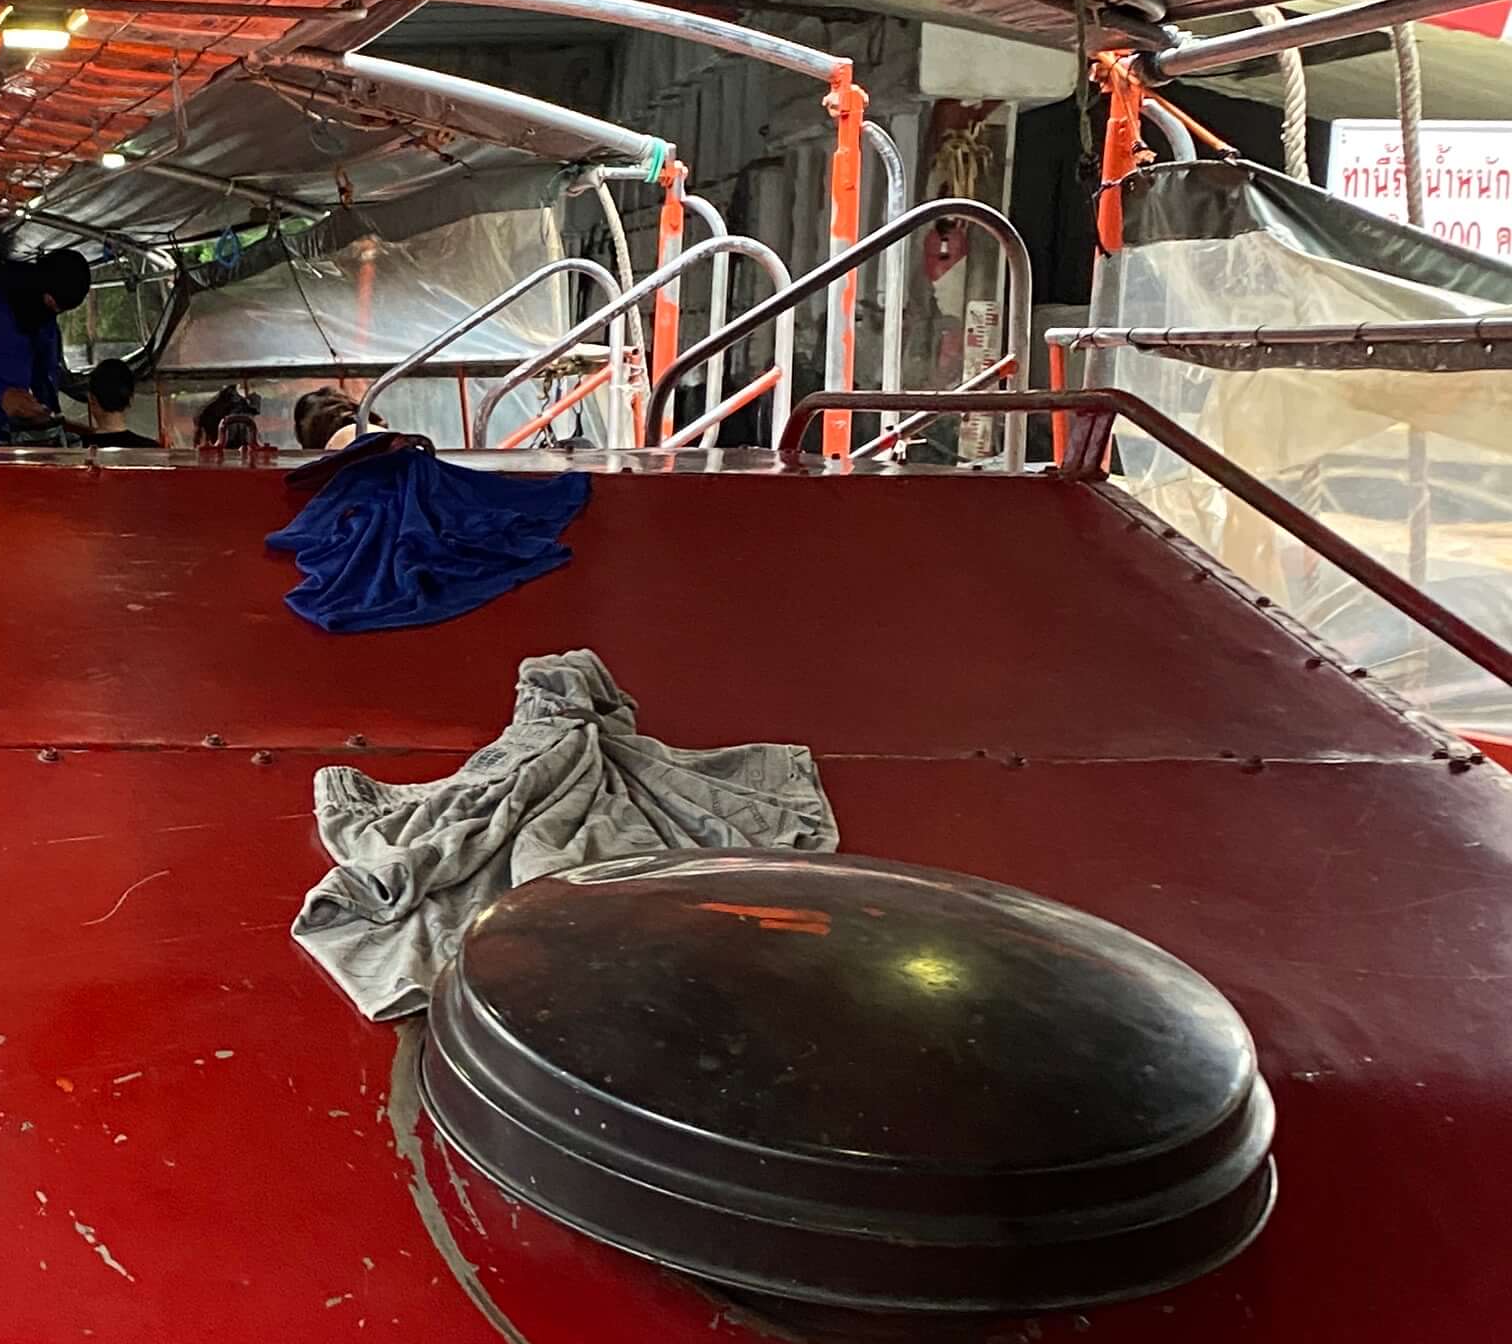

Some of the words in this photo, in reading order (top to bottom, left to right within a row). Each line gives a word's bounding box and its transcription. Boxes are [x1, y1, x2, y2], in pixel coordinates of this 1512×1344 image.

[1342, 143, 1510, 200] ท่านี้รัน้ำหนัก
